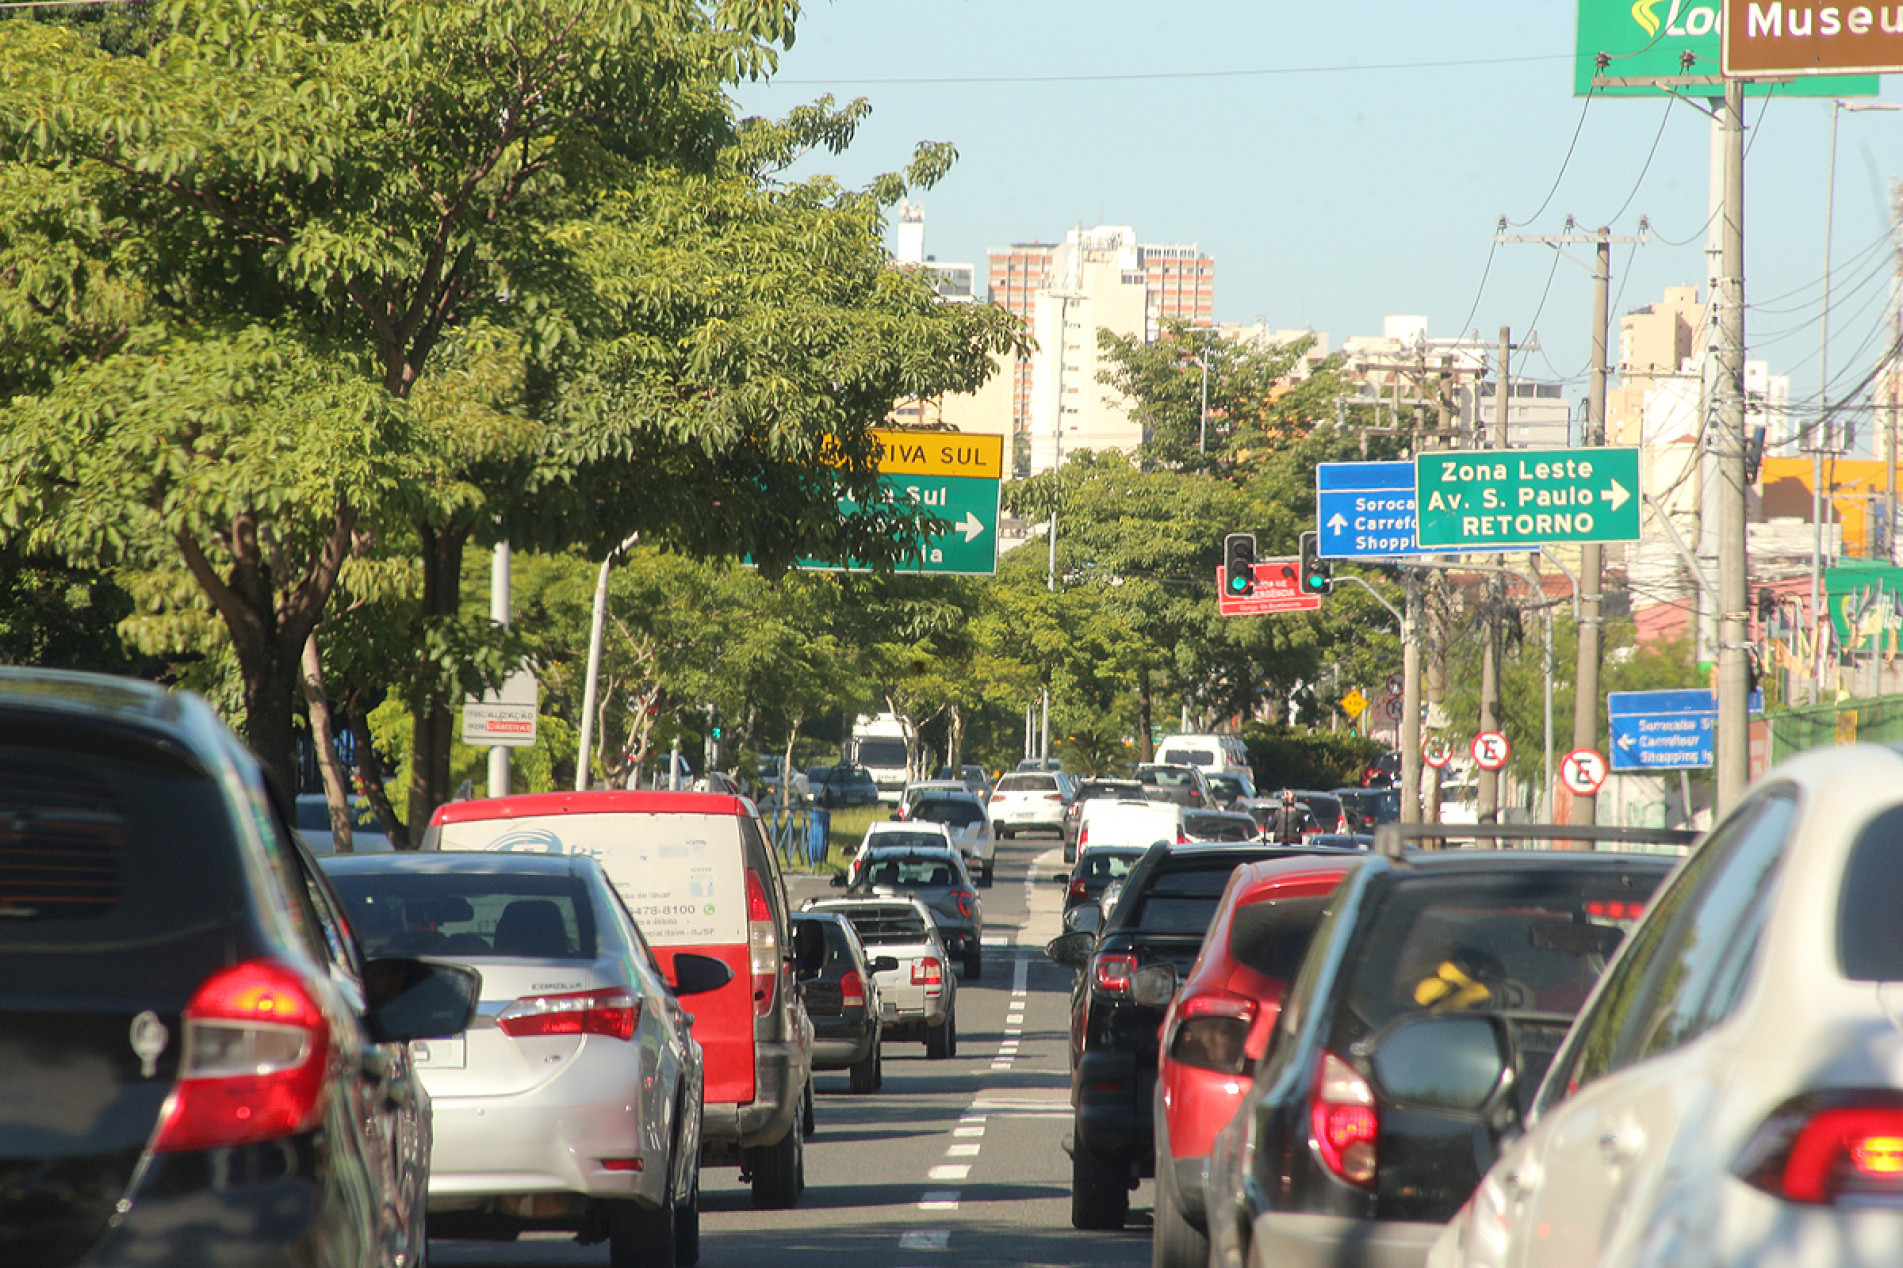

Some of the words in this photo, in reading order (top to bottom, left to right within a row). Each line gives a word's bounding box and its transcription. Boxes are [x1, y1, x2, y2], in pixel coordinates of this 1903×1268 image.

[1747, 1, 1903, 37] Museu
[941, 446, 987, 467] SUL
[1440, 462, 1507, 483] Zona
[1518, 459, 1594, 480] Leste
[906, 485, 947, 506] Sul
[1428, 491, 1470, 511] Av.
[1482, 489, 1506, 509] S.
[1518, 486, 1593, 507] Paulo
[1462, 512, 1594, 537] RETORNO
